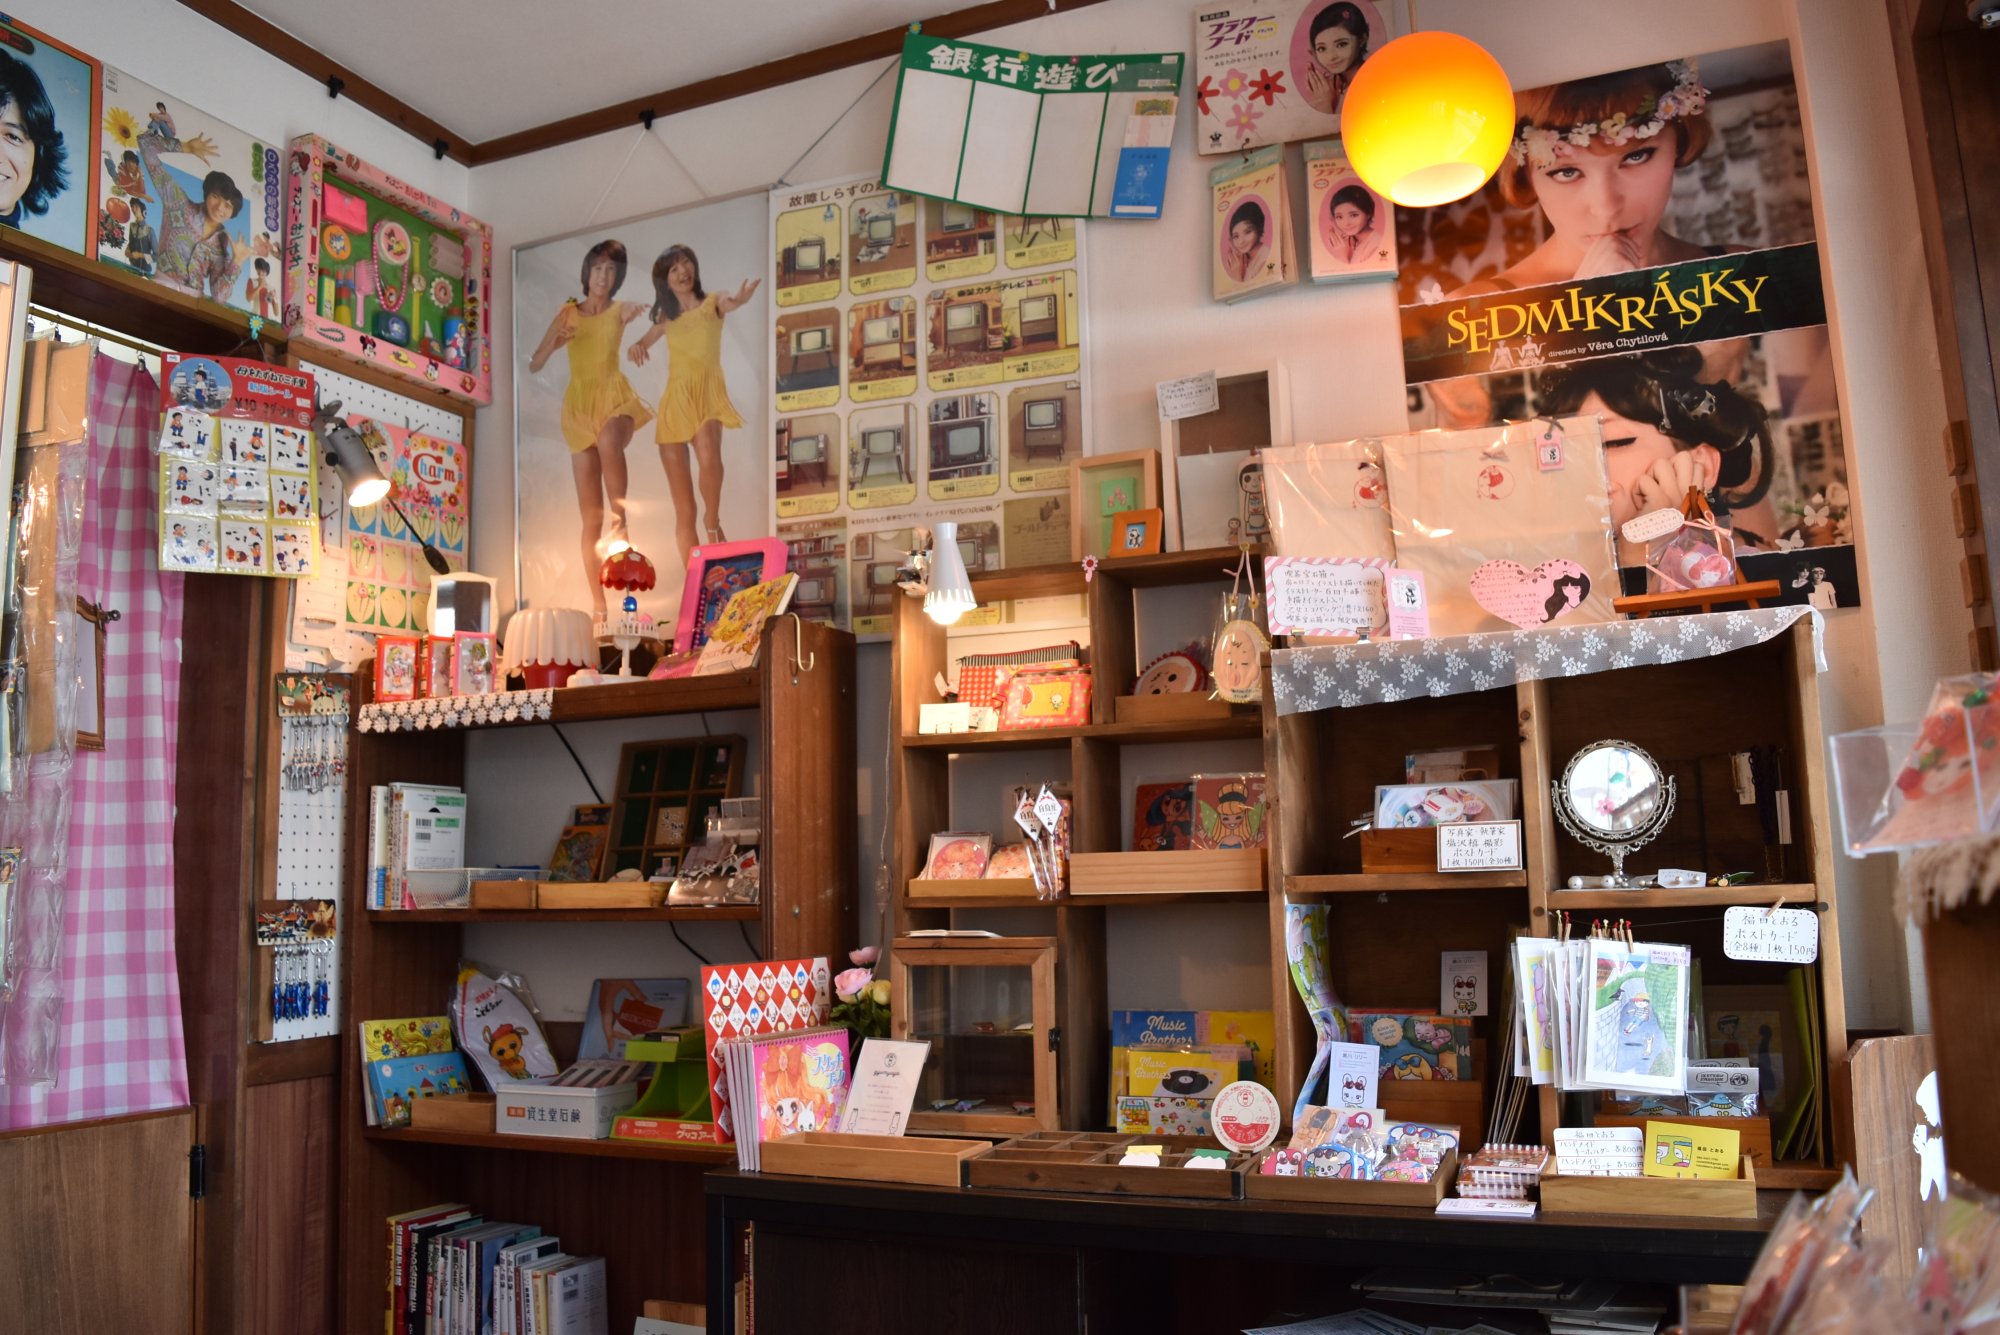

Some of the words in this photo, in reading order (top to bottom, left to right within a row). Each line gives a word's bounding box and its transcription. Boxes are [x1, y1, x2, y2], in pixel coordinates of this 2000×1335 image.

[1205, 16, 1276, 37] フラワー
[1205, 30, 1254, 51] フード
[926, 44, 1126, 90] 銀行遊び
[1447, 269, 1769, 355] SEDMIKRÁSKY
[1548, 346, 1577, 358] directed
[1577, 346, 1587, 356] by
[1616, 331, 1669, 350] Chytilová
[236, 366, 306, 389] 母をたずねて三千里
[413, 453, 456, 485] Charm
[1453, 847, 1498, 857] ポストカード
[1742, 914, 1800, 927] 福田とおる
[1735, 928, 1798, 941] ポストカード
[1147, 1015, 1187, 1031] Music
[1140, 1030, 1193, 1046] Brothers
[813, 1050, 844, 1076] スケッチ
[1139, 1056, 1167, 1068] Music
[1135, 1067, 1172, 1080] Brothers
[527, 1106, 581, 1124] 資生堂石鹸
[1574, 1130, 1615, 1139] 福田とおる
[1559, 1141, 1596, 1149] ハンドメイド
[1575, 1148, 1611, 1156] キーホルダー
[1560, 1157, 1600, 1165] ハンドメイド
